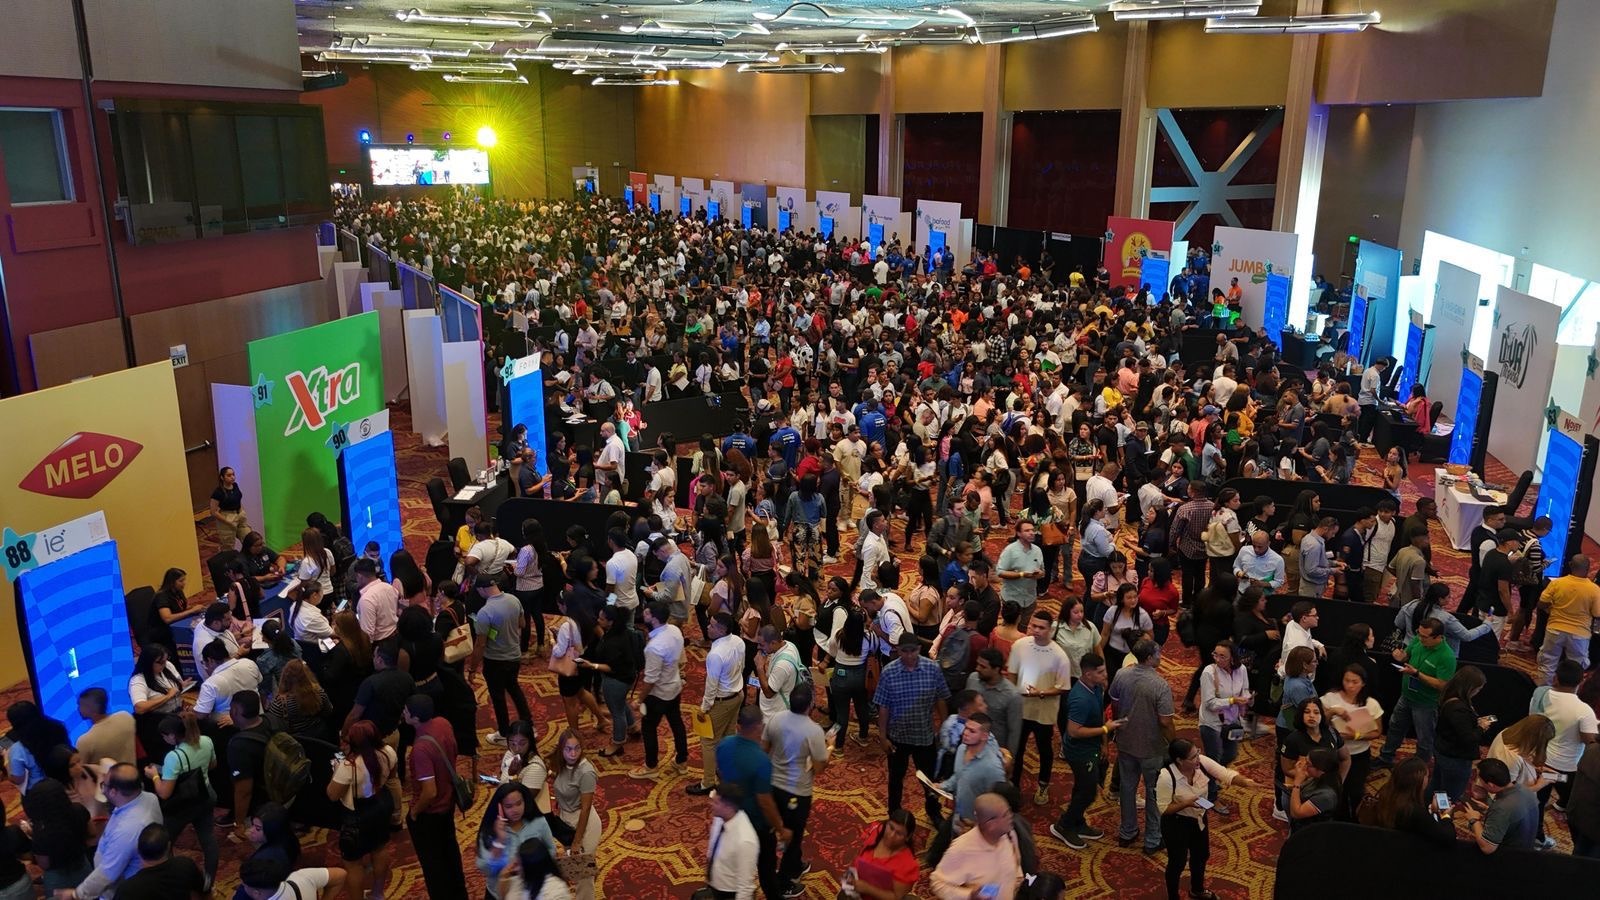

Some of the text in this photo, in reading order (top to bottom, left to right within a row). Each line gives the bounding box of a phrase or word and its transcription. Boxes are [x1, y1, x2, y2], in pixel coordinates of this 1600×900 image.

[1228, 259, 1266, 274] JUMB
[171, 356, 187, 366] EXIT
[505, 363, 513, 378] 92
[257, 386, 268, 400] 91
[284, 362, 361, 437] Xtra
[332, 429, 346, 449] 90
[44, 443, 124, 489] MELO
[5, 539, 32, 569] 88
